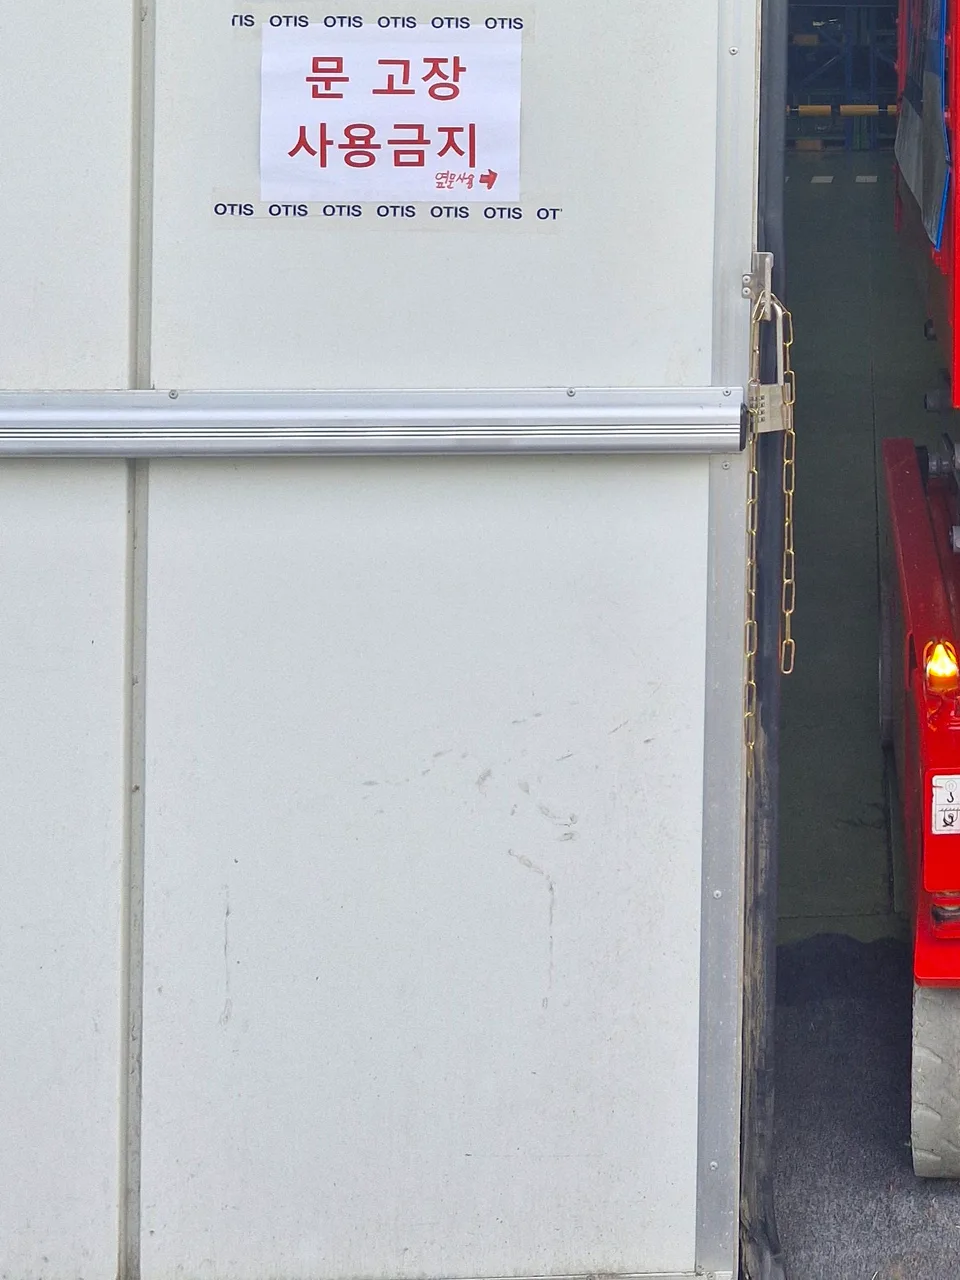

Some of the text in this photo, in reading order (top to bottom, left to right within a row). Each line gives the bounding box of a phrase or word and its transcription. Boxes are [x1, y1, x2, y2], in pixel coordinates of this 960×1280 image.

[269, 15, 309, 28] OTIS
[323, 15, 363, 29] OTIS
[377, 16, 417, 29] OTIS
[431, 16, 471, 29] OTIS
[484, 17, 524, 30] OTIS
[305, 55, 467, 102] 문 고장
[287, 122, 476, 169] 사용금지
[213, 203, 563, 220] OTIS OTIS OTIS OTIS OTIS OTIS OT
